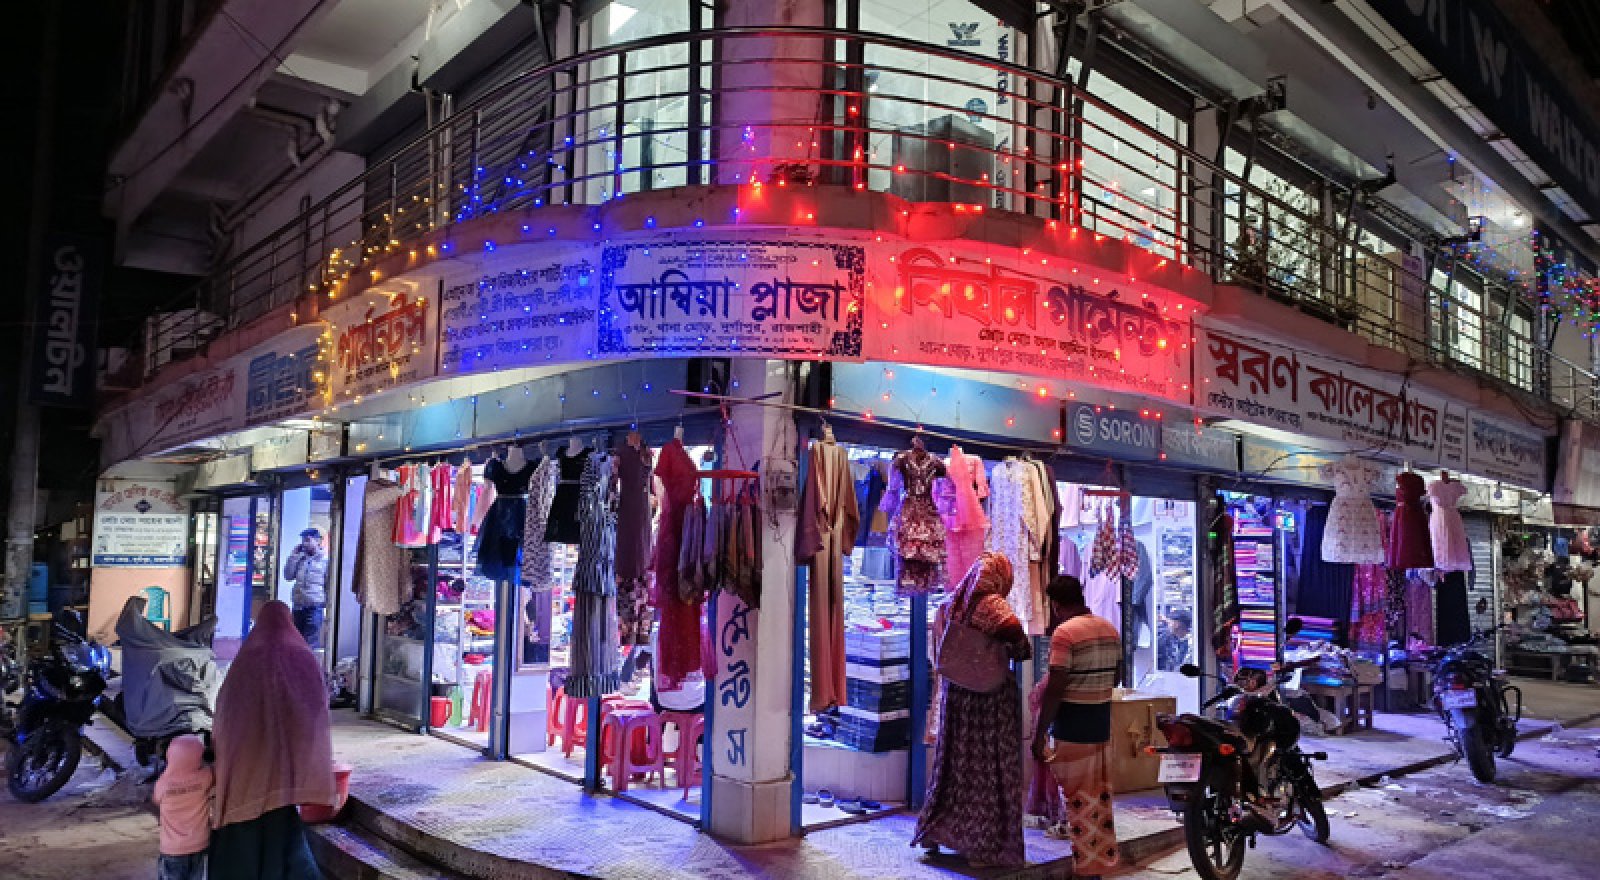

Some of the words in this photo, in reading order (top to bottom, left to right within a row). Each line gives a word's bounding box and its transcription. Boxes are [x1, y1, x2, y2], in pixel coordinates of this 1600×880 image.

[42, 245, 85, 396] ওয়ালটন
[616, 268, 736, 318] আম্বিয়া
[750, 275, 846, 321] প্লাজা
[1208, 333, 1300, 403] স্বরণ
[1099, 416, 1156, 449] SORON
